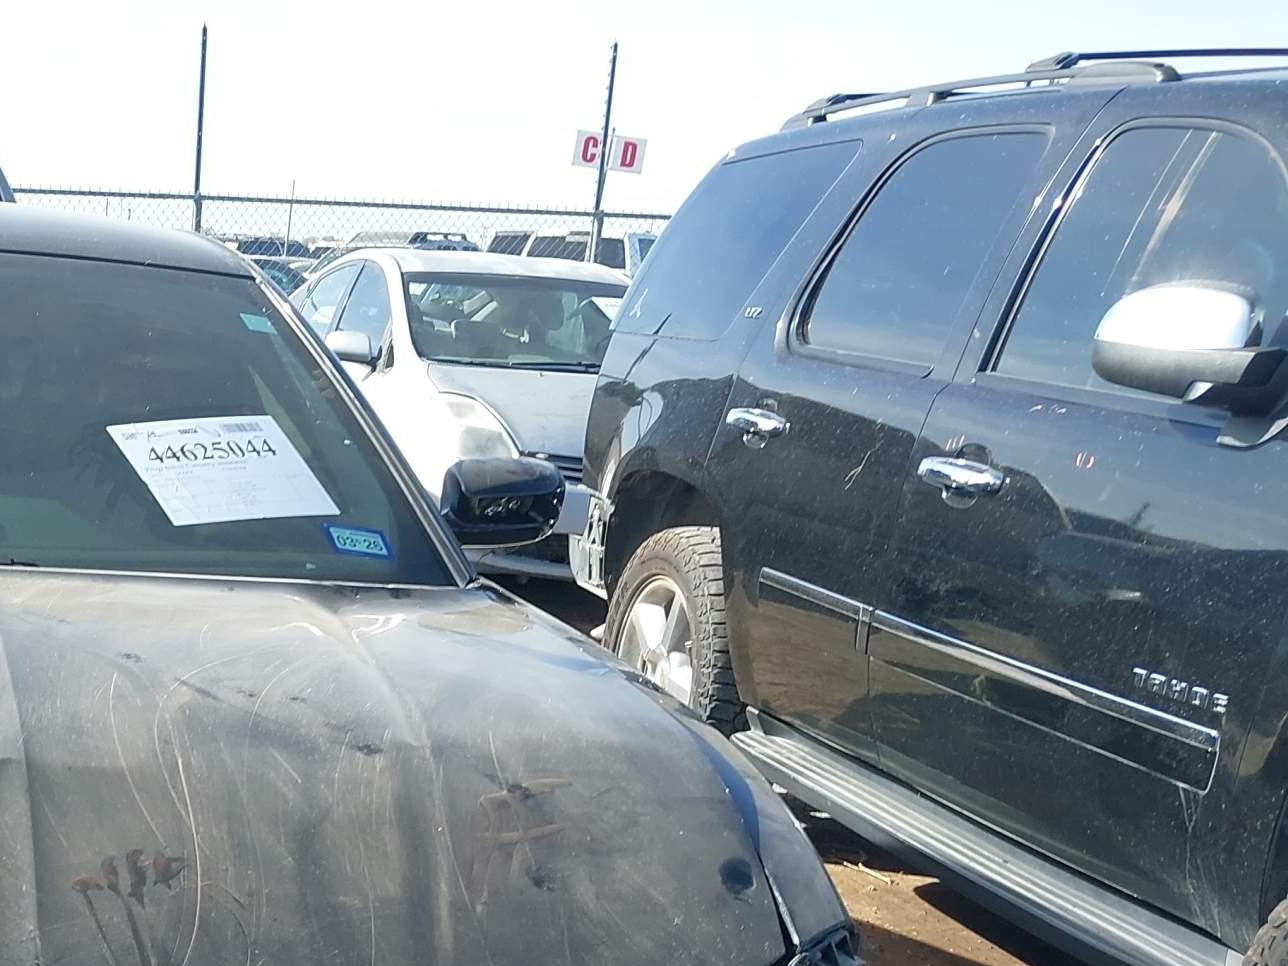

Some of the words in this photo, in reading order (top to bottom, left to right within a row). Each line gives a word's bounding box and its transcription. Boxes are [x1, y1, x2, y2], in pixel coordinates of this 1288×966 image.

[582, 136, 598, 163] C
[620, 141, 637, 168] D
[148, 438, 277, 463] 44625044
